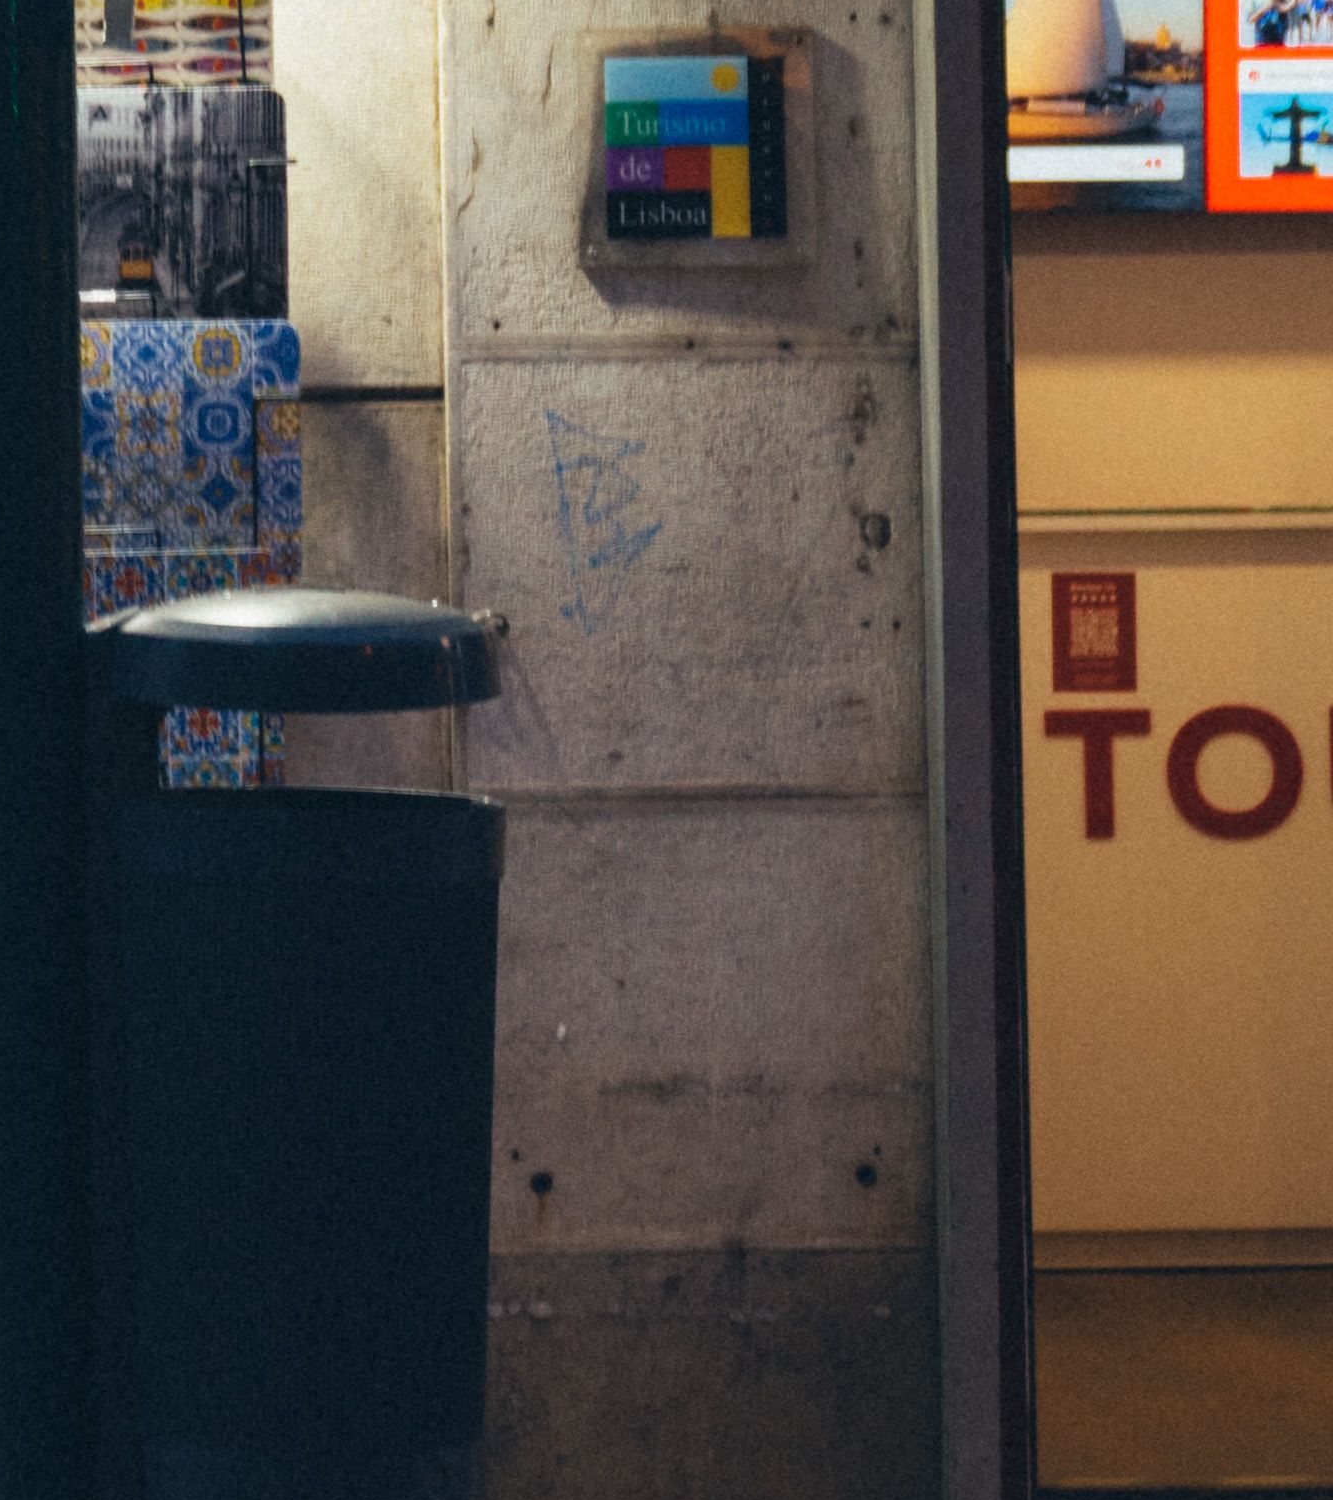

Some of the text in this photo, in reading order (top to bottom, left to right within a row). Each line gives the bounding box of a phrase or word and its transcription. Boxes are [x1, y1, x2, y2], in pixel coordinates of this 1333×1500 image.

[617, 111, 728, 137] Turismo
[619, 156, 651, 183] de
[619, 201, 707, 227] Lisboa
[1044, 704, 1333, 842] TO
